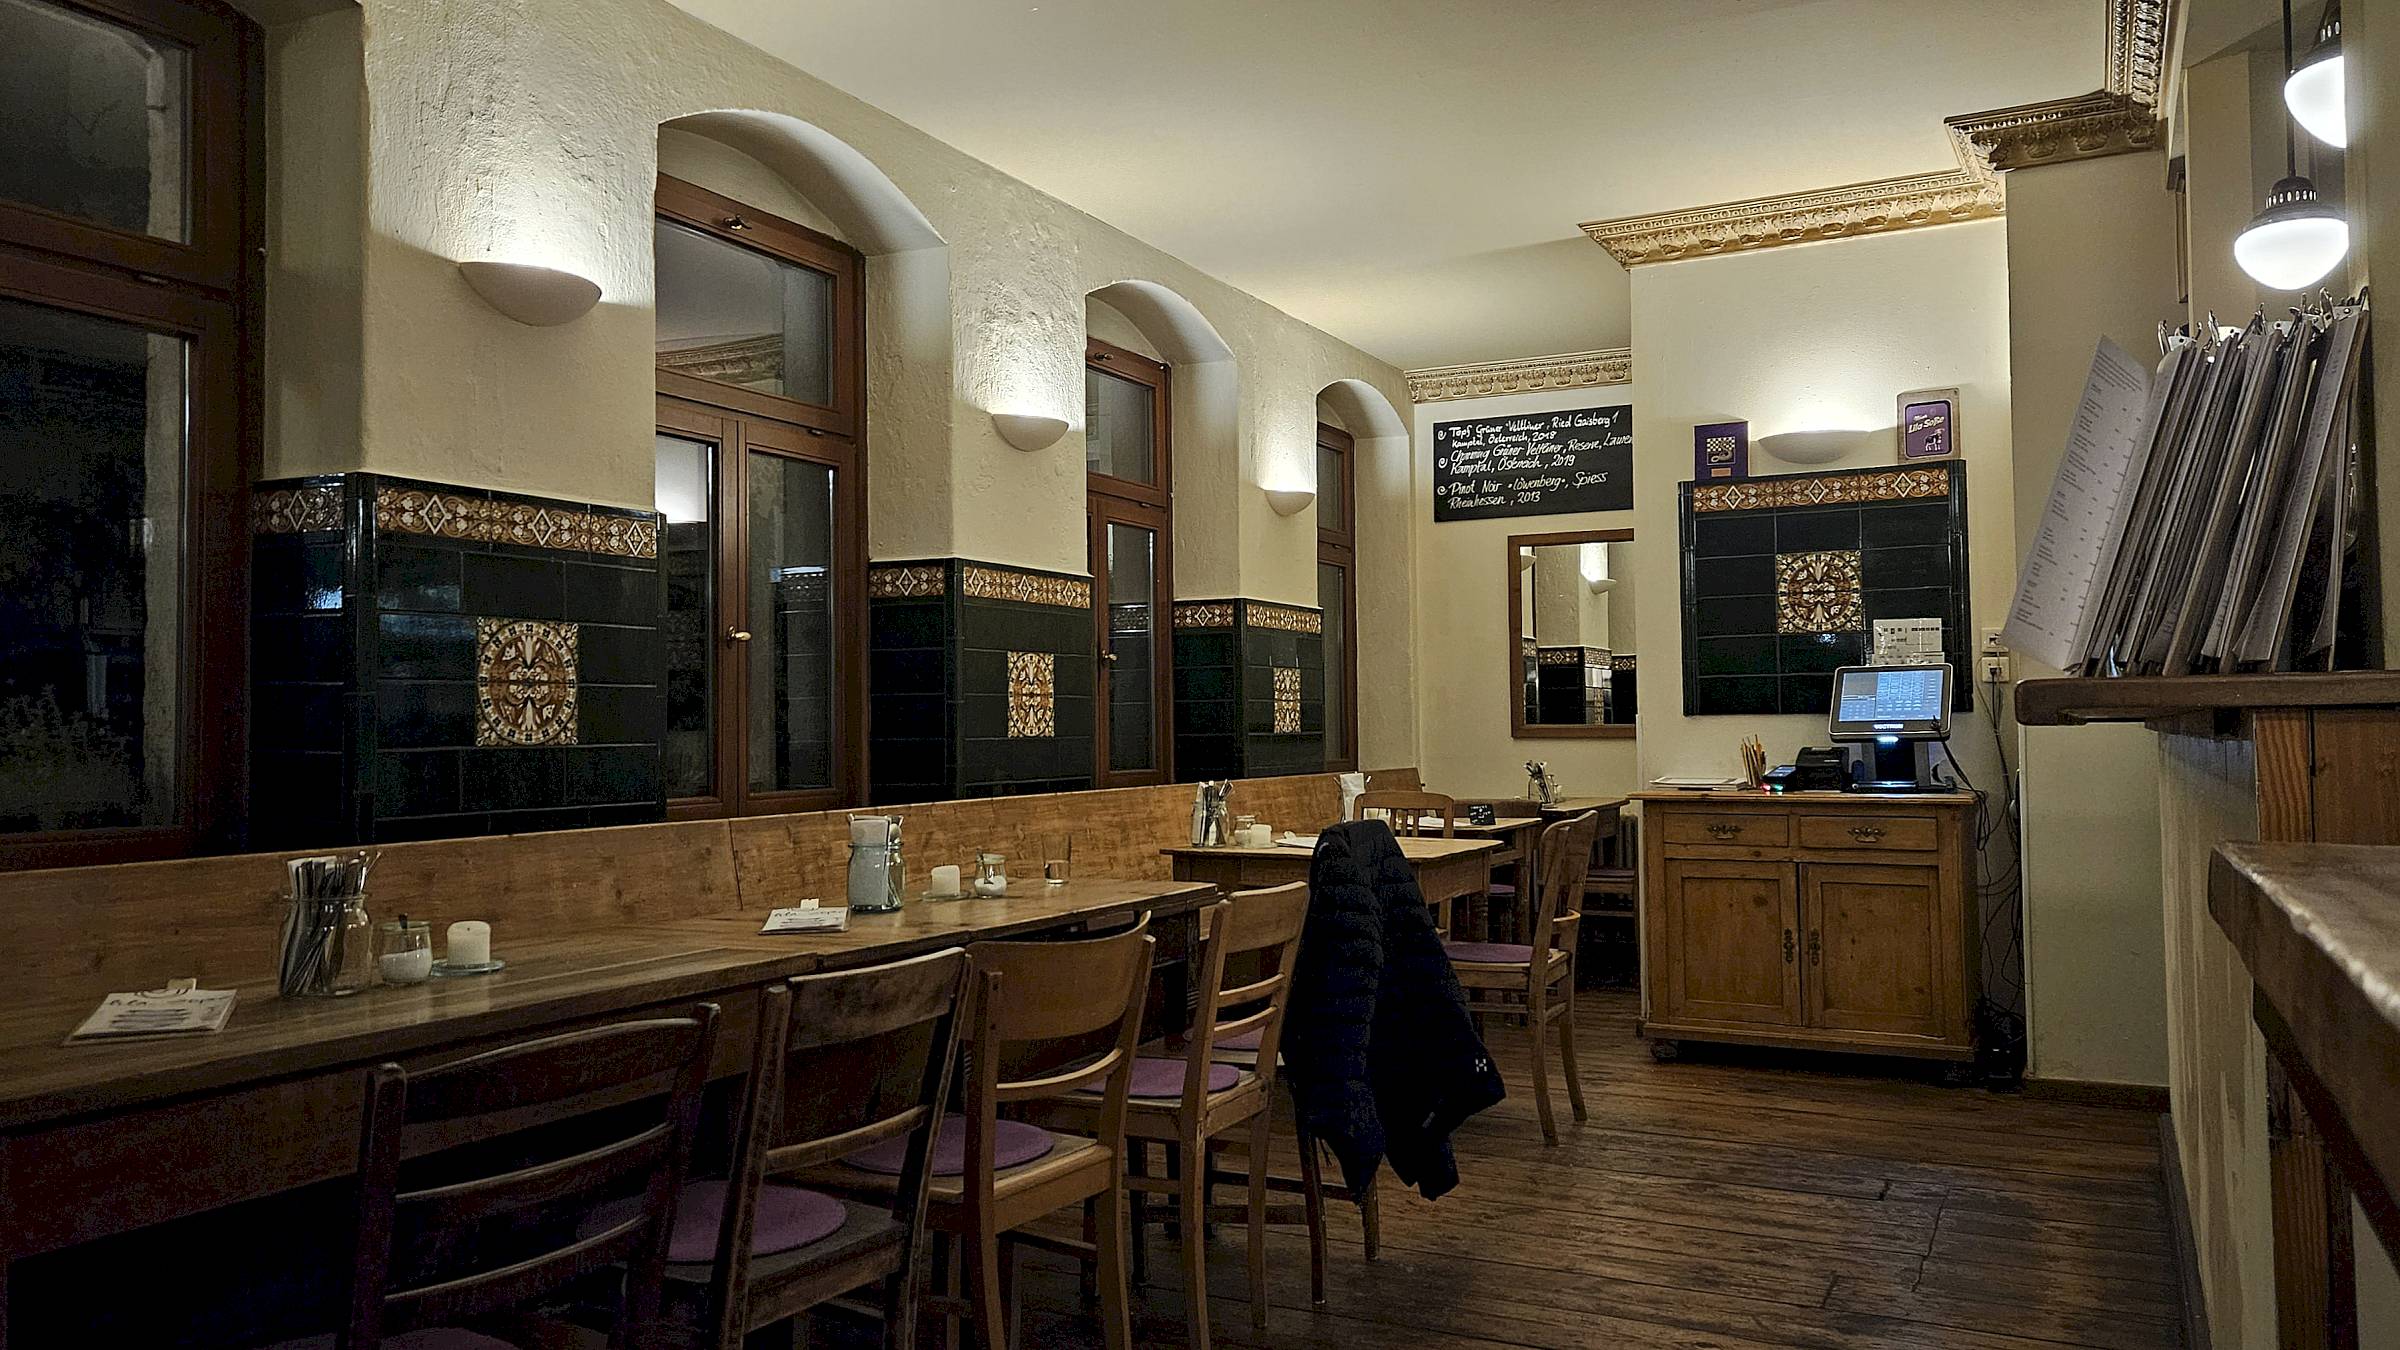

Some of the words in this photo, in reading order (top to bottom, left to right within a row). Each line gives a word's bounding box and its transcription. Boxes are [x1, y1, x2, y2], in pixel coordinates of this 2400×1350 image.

[1551, 414, 1572, 429] Ried
[1908, 422, 1923, 434] Lila
[1550, 453, 1576, 467] 2019
[1448, 479, 1475, 496] Pinot
[1481, 479, 1503, 494] Noir
[1572, 471, 1609, 489] Spiess
[1517, 491, 1541, 504] 2013
